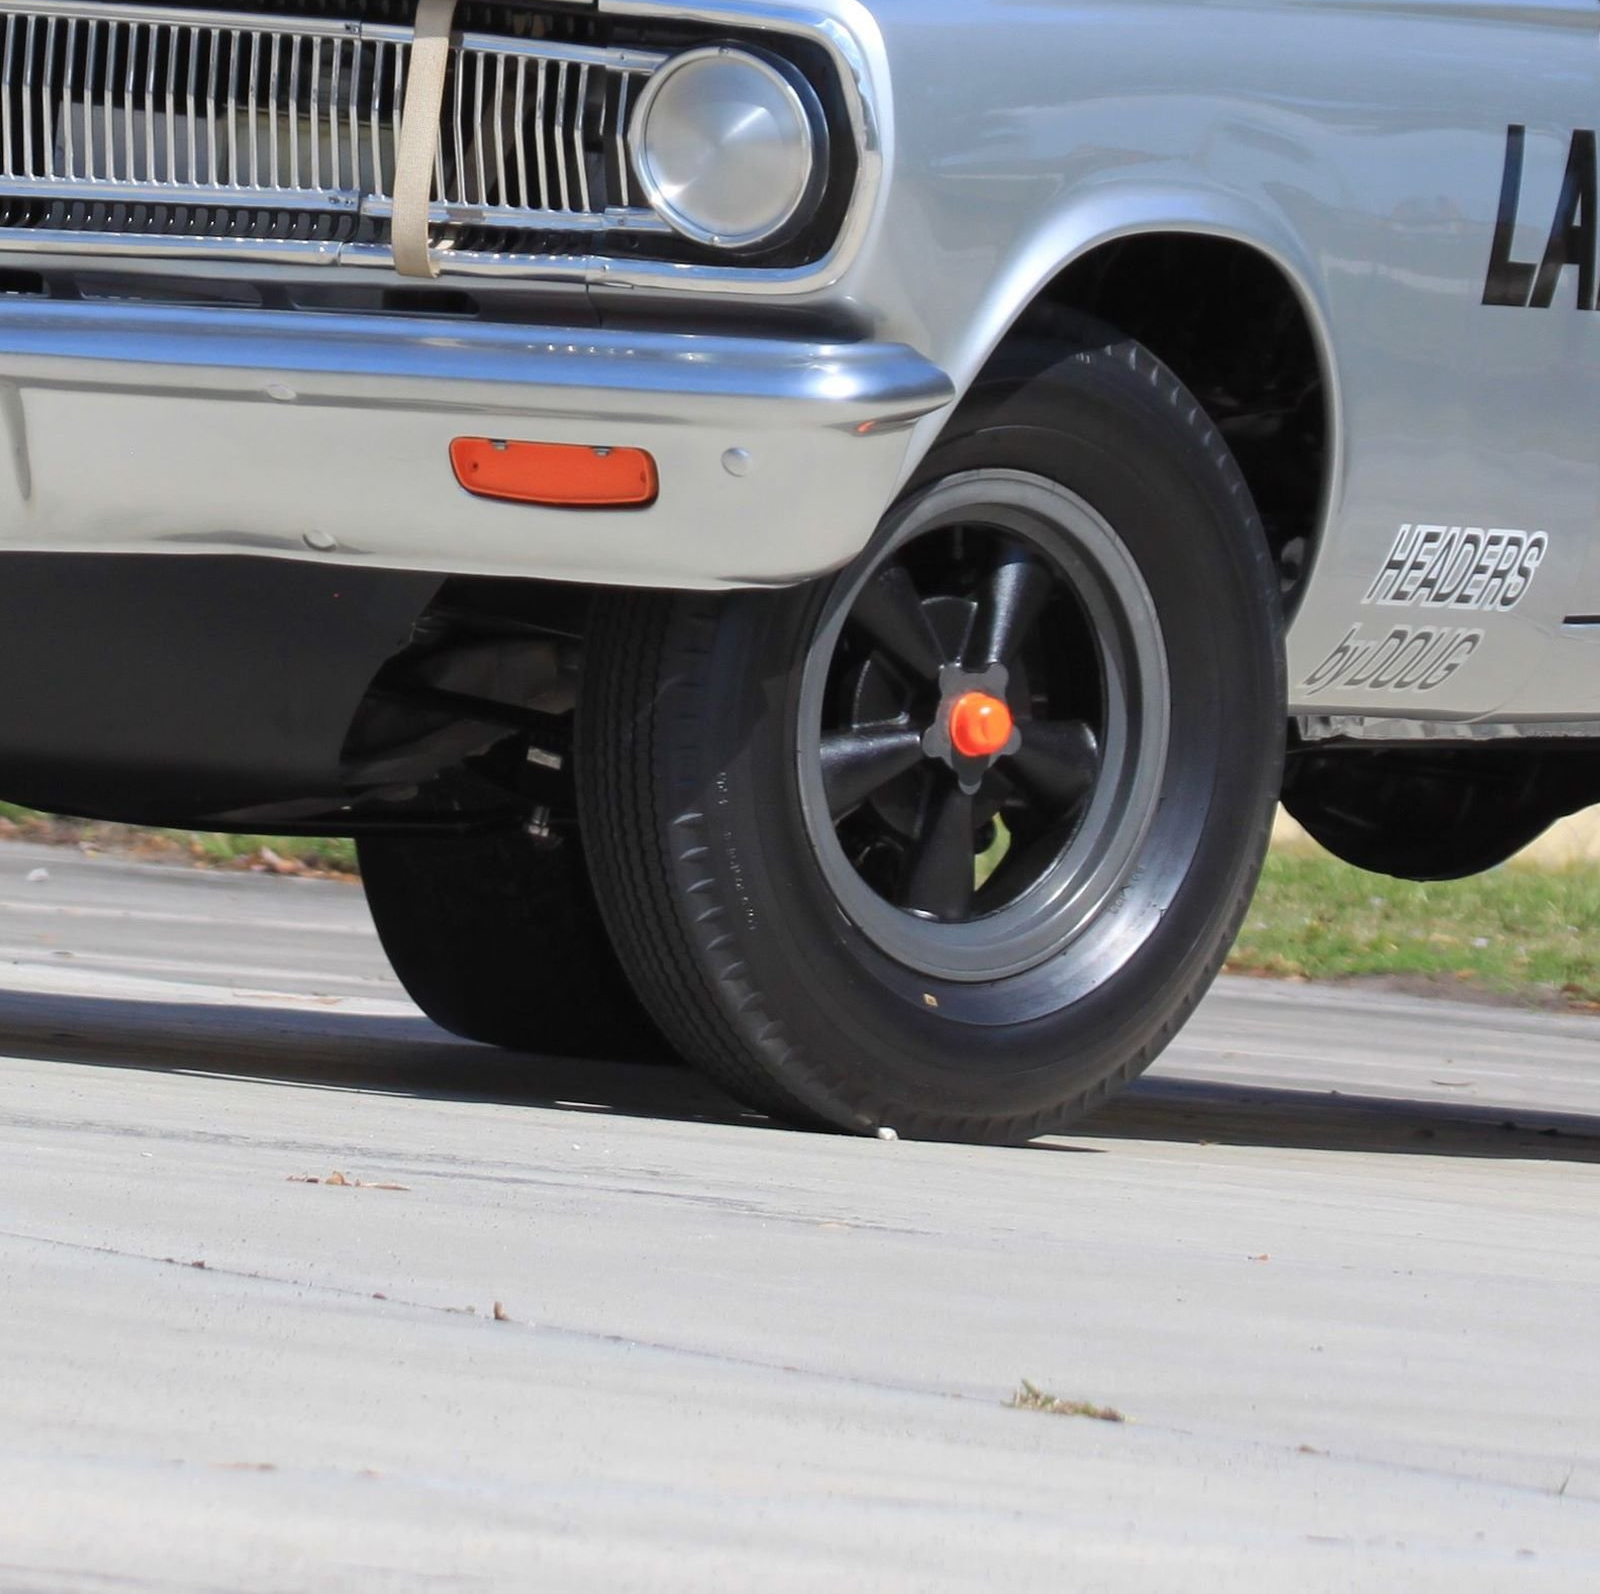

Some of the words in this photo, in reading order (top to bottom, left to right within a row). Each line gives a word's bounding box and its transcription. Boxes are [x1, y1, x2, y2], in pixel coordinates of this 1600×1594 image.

[1360, 524, 1549, 611] HEADERS
[1295, 622, 1378, 697] by
[1337, 624, 1485, 693] DOUG
